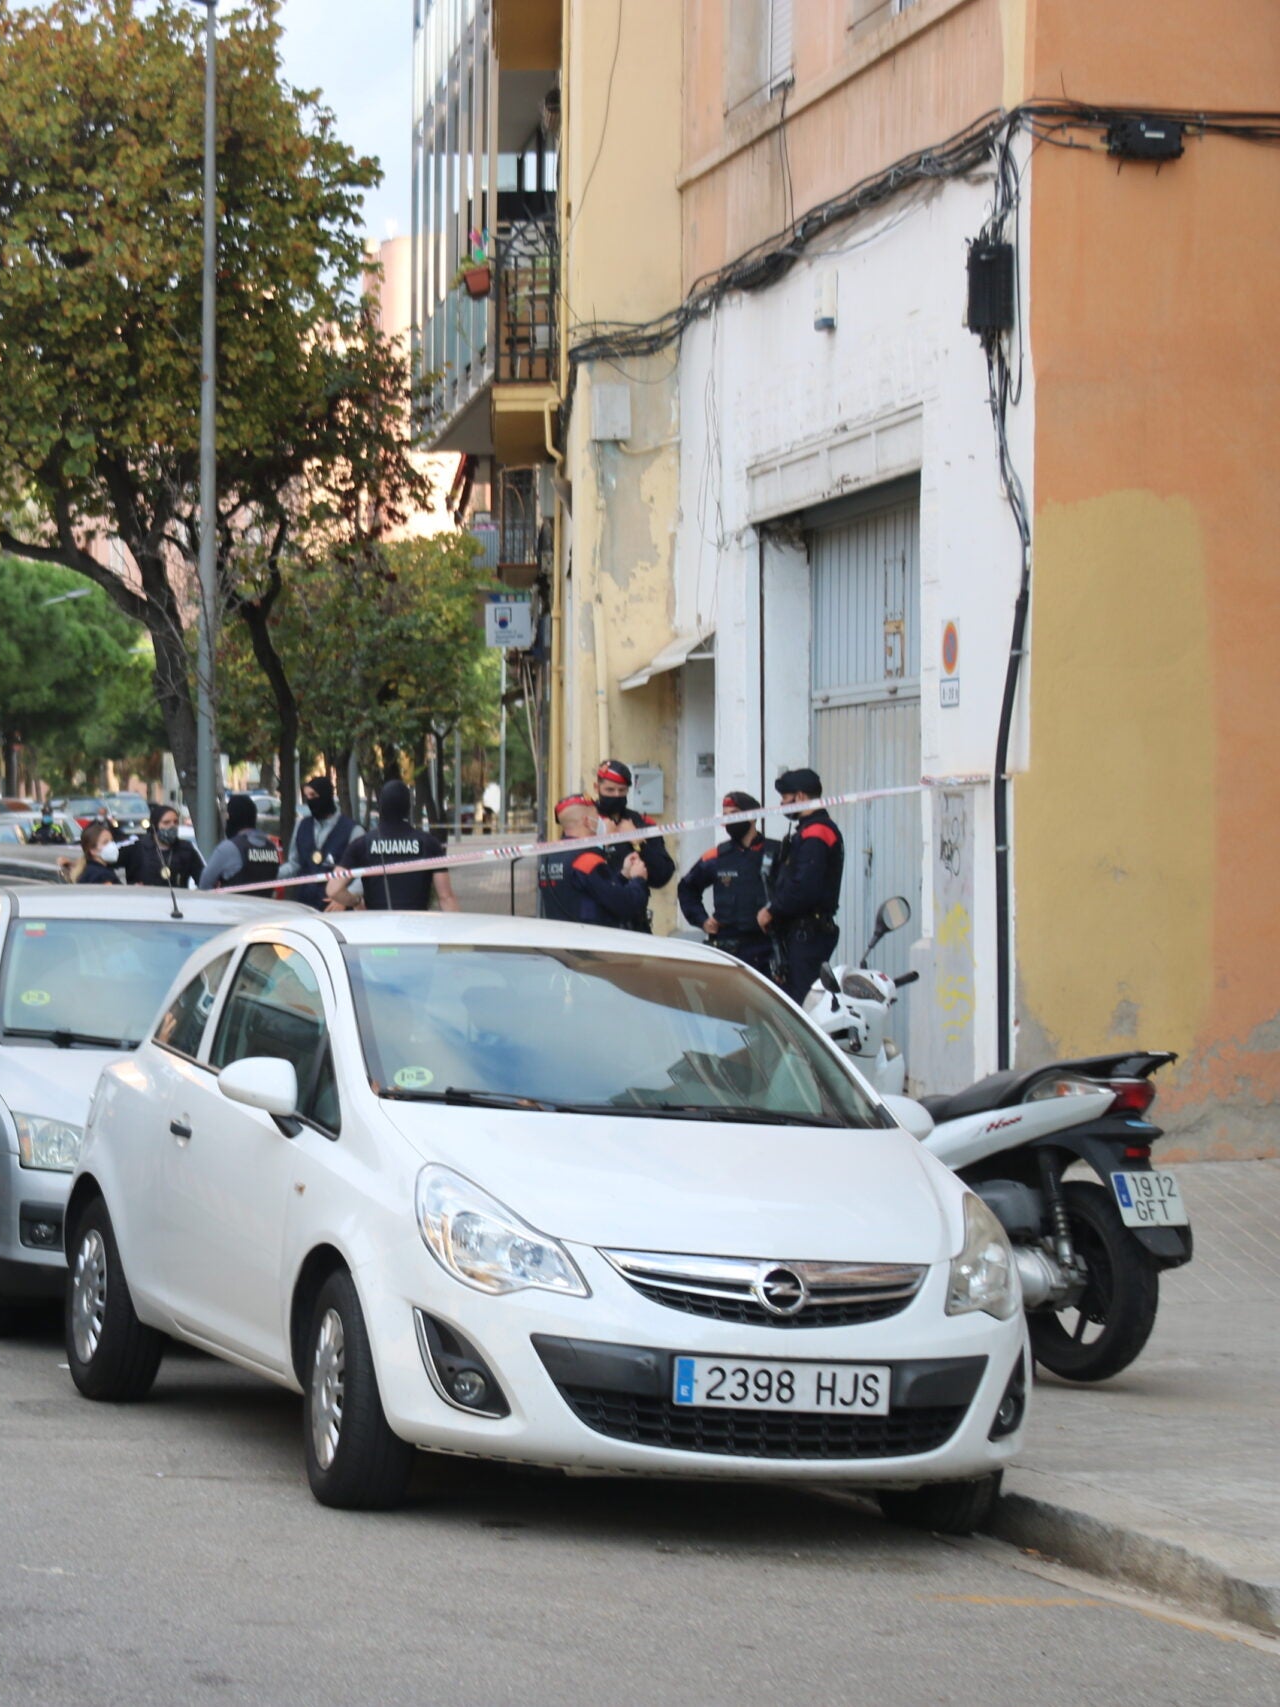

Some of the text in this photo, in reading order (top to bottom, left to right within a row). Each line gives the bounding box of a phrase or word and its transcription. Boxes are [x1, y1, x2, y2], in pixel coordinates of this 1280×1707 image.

[248, 847, 278, 864] ADUANAS
[371, 839, 420, 855] ADUANAS
[1131, 1175, 1177, 1198] 1912
[1135, 1199, 1169, 1222] GFT
[705, 1365, 796, 1404] 2398
[815, 1371, 880, 1408] HJS
